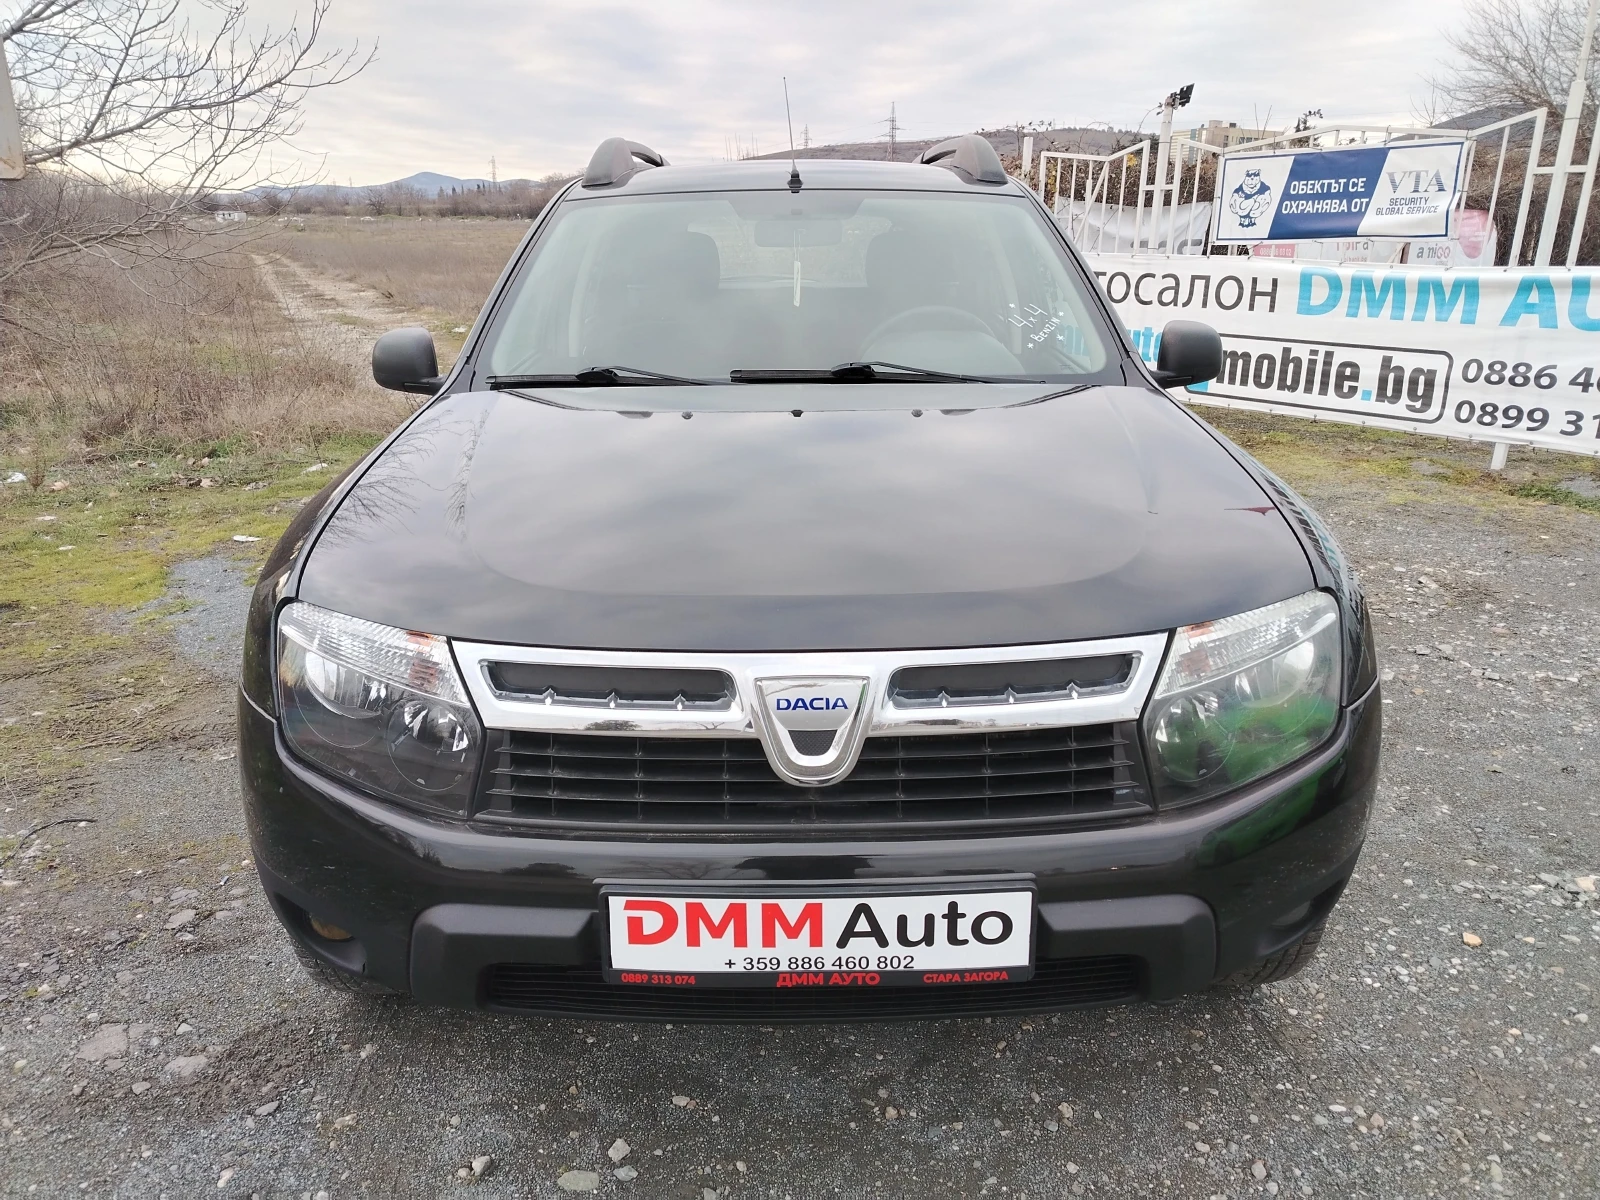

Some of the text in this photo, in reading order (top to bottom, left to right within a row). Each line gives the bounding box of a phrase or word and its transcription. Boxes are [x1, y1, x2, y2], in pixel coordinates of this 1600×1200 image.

[1289, 178, 1367, 195] ОБЕКТЪТ СЕ
[1386, 169, 1447, 194] VTA
[1281, 198, 1369, 214] ОХРАНЯВА ОТ
[1389, 196, 1430, 206] SECURITY
[1375, 205, 1440, 216] GLOBAL SERVICE
[1296, 266, 1480, 325] DMM
[1215, 346, 1438, 414] mobile.bg
[1461, 358, 1600, 393] 0886 4
[1454, 399, 1550, 432] 0899
[776, 697, 848, 711] DACIA
[623, 899, 1014, 949] DMM Auto
[743, 956, 781, 970] 359
[787, 956, 826, 970] 886
[831, 956, 870, 970] 460
[876, 955, 915, 970] 802
[621, 972, 696, 985] 0889 313 074
[776, 972, 881, 988] ДММ АУТО
[923, 971, 1009, 983] СТАРА ЗАГОРА
